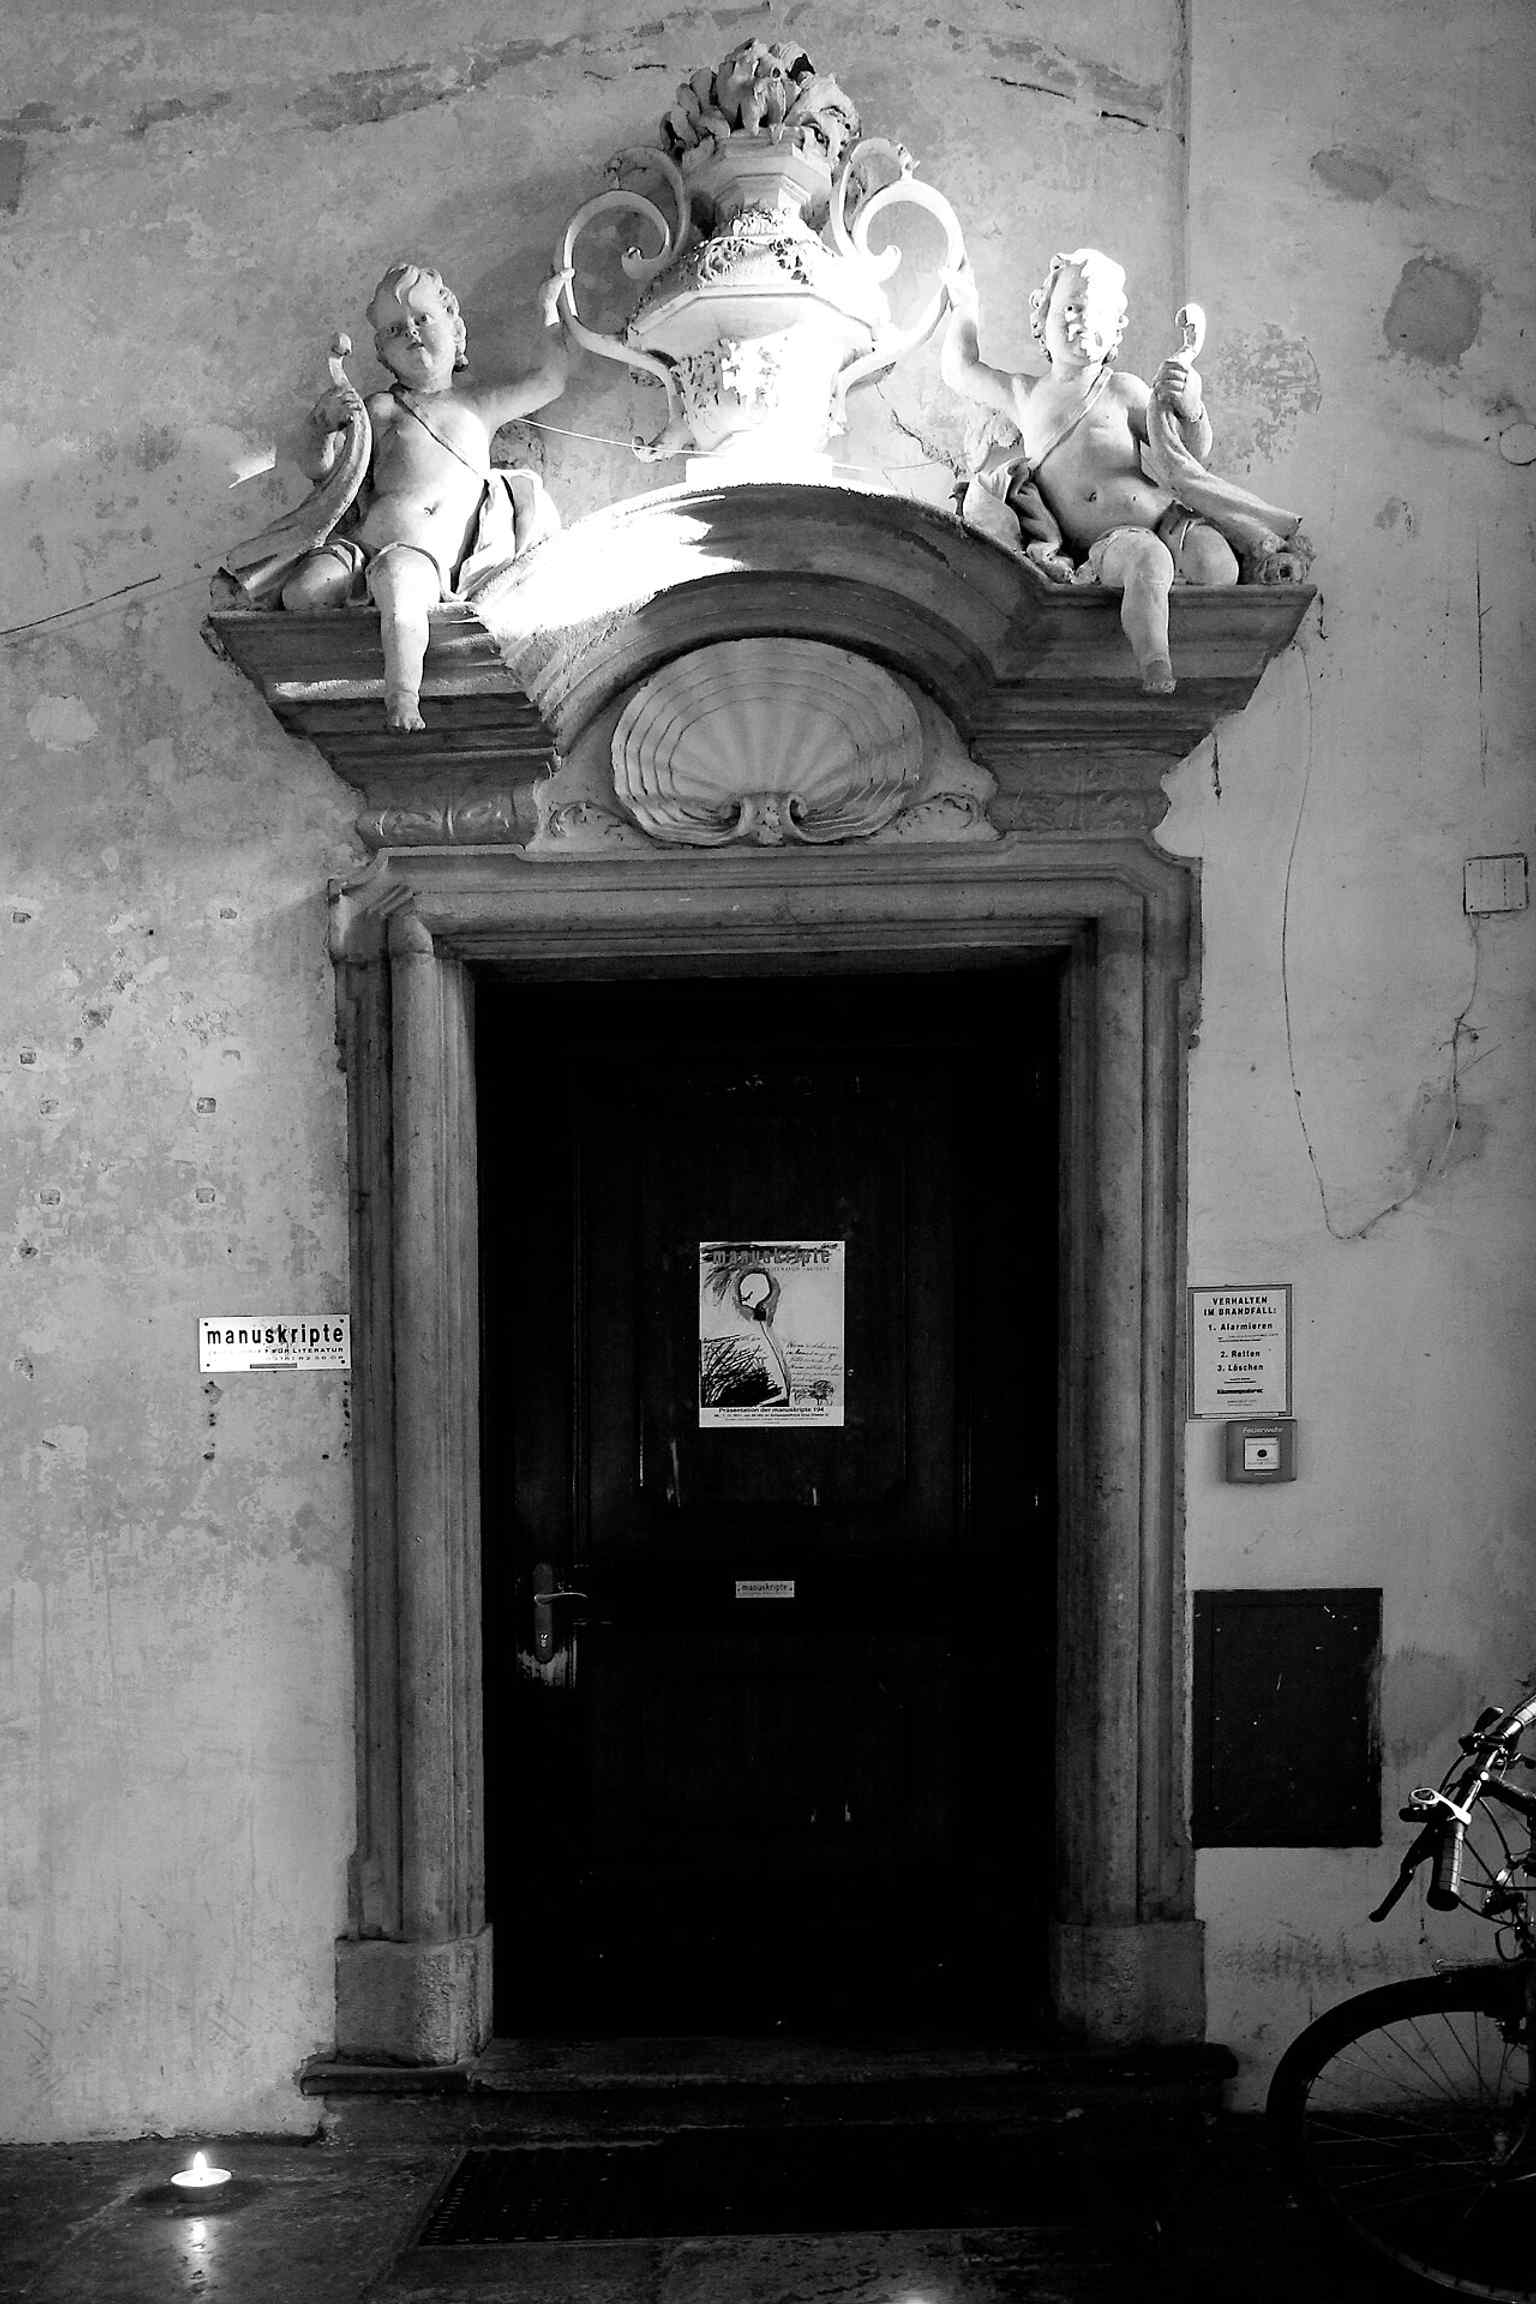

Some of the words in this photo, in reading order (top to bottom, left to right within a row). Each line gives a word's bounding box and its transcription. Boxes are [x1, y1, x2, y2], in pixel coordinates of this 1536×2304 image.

[1212, 1296, 1268, 1305] VERHALTEN
[1203, 1308, 1215, 1316] IM
[1218, 1307, 1277, 1316] BRANDFALL:
[1220, 1322, 1273, 1331] Alarmieren
[207, 1323, 344, 1346] manuskripte
[1231, 1350, 1260, 1358] Retten
[1216, 1364, 1225, 1372] 3.
[1228, 1363, 1264, 1372] Löschen
